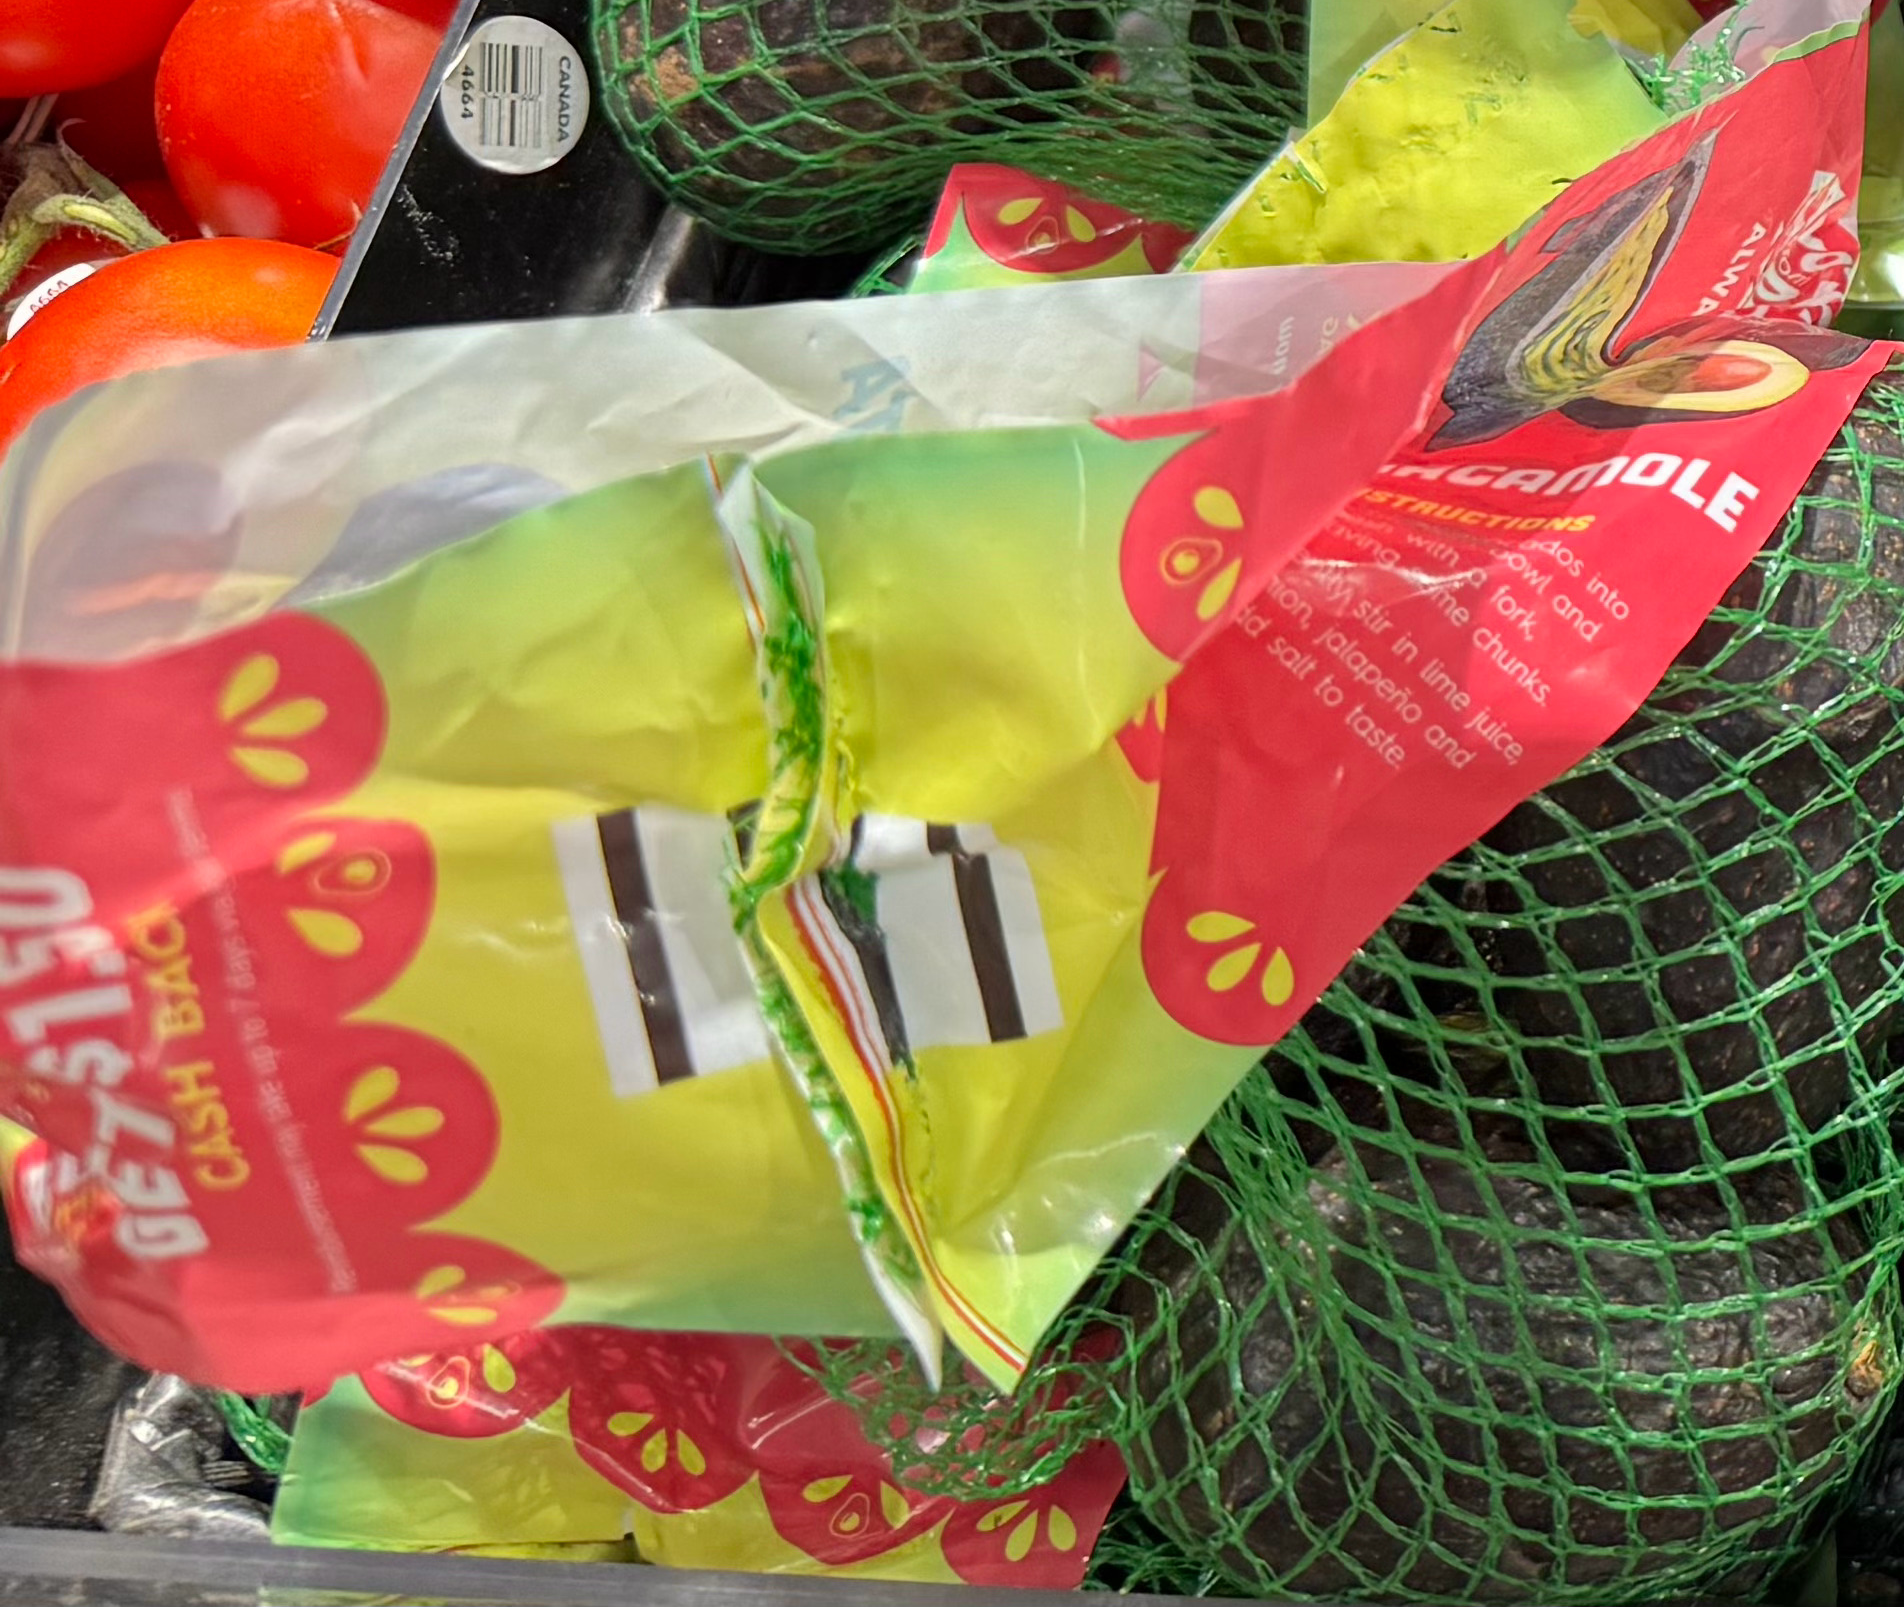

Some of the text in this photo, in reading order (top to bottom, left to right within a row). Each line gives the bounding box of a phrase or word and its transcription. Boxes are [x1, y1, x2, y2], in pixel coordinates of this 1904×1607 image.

[461, 65, 475, 119] 4664
[557, 56, 572, 142] CANADA
[1362, 488, 1596, 532] STRUCTIONS
[1408, 533, 1536, 642] with a fork,
[1551, 594, 1603, 644] and
[1587, 571, 1631, 621] into
[1267, 633, 1318, 681] salt
[1314, 675, 1345, 709] to
[1344, 703, 1407, 769] taste.
[1315, 625, 1423, 725] jalapeño
[1425, 722, 1477, 770] and
[1353, 599, 1527, 767] stir in lime juice,
[1472, 625, 1552, 707] chunks.
[127, 902, 206, 1040] BAC
[82, 1087, 211, 1259] GET
[165, 1061, 250, 1190] CASH
